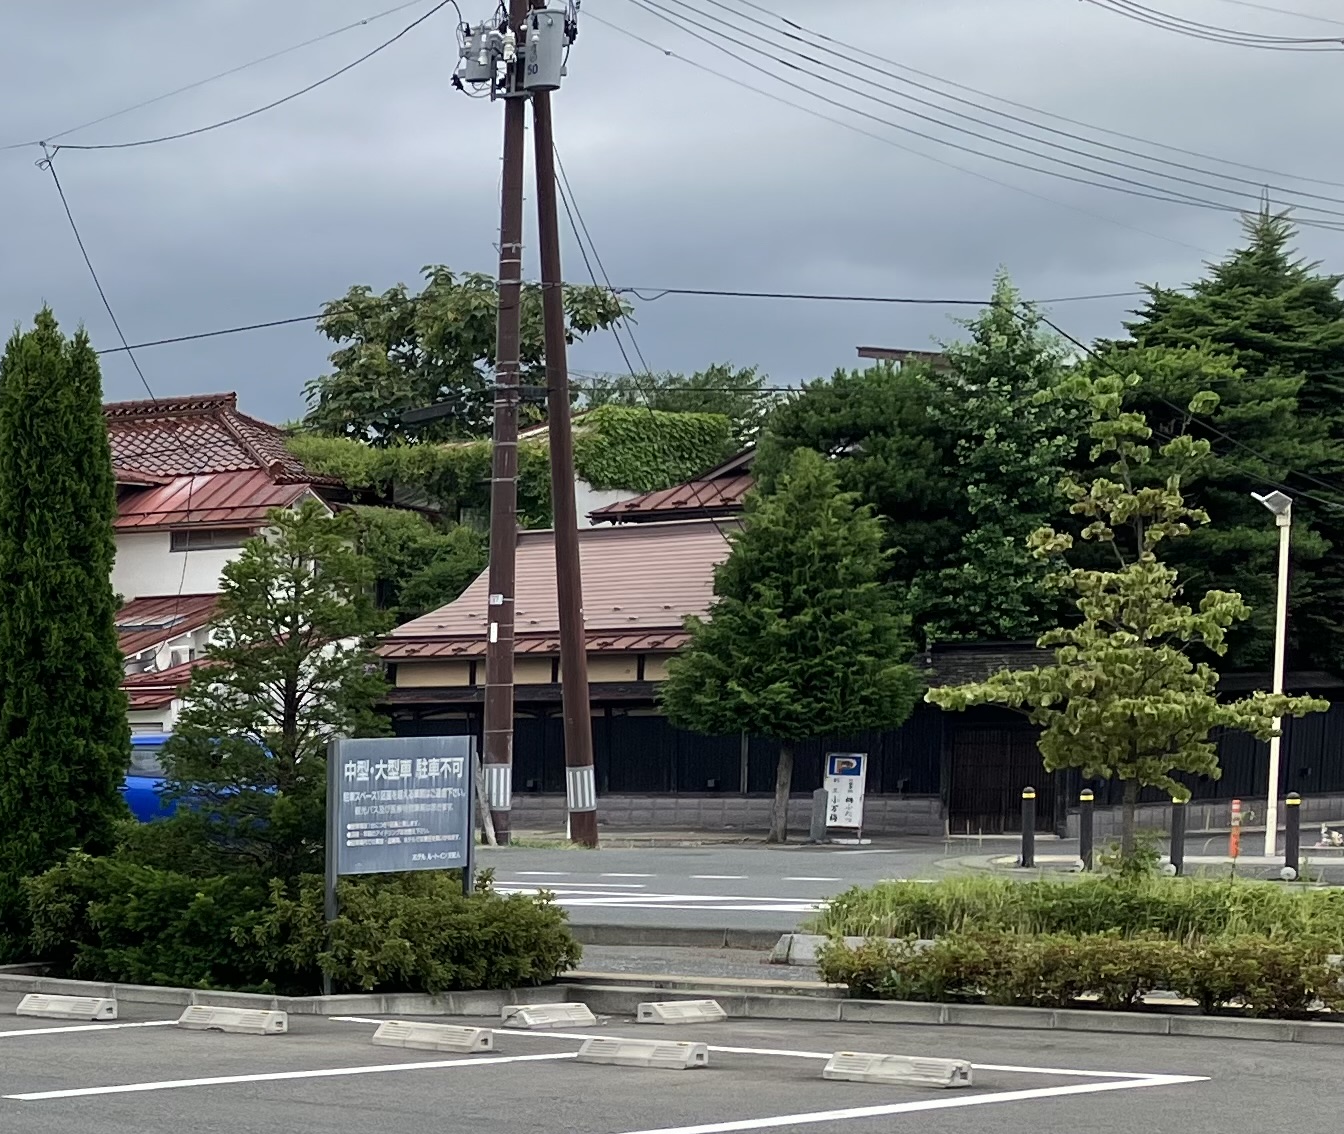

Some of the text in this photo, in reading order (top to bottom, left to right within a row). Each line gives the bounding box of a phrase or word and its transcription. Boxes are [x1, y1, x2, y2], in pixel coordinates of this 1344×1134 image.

[343, 756, 465, 782] 中型・大型車 駐車不可
